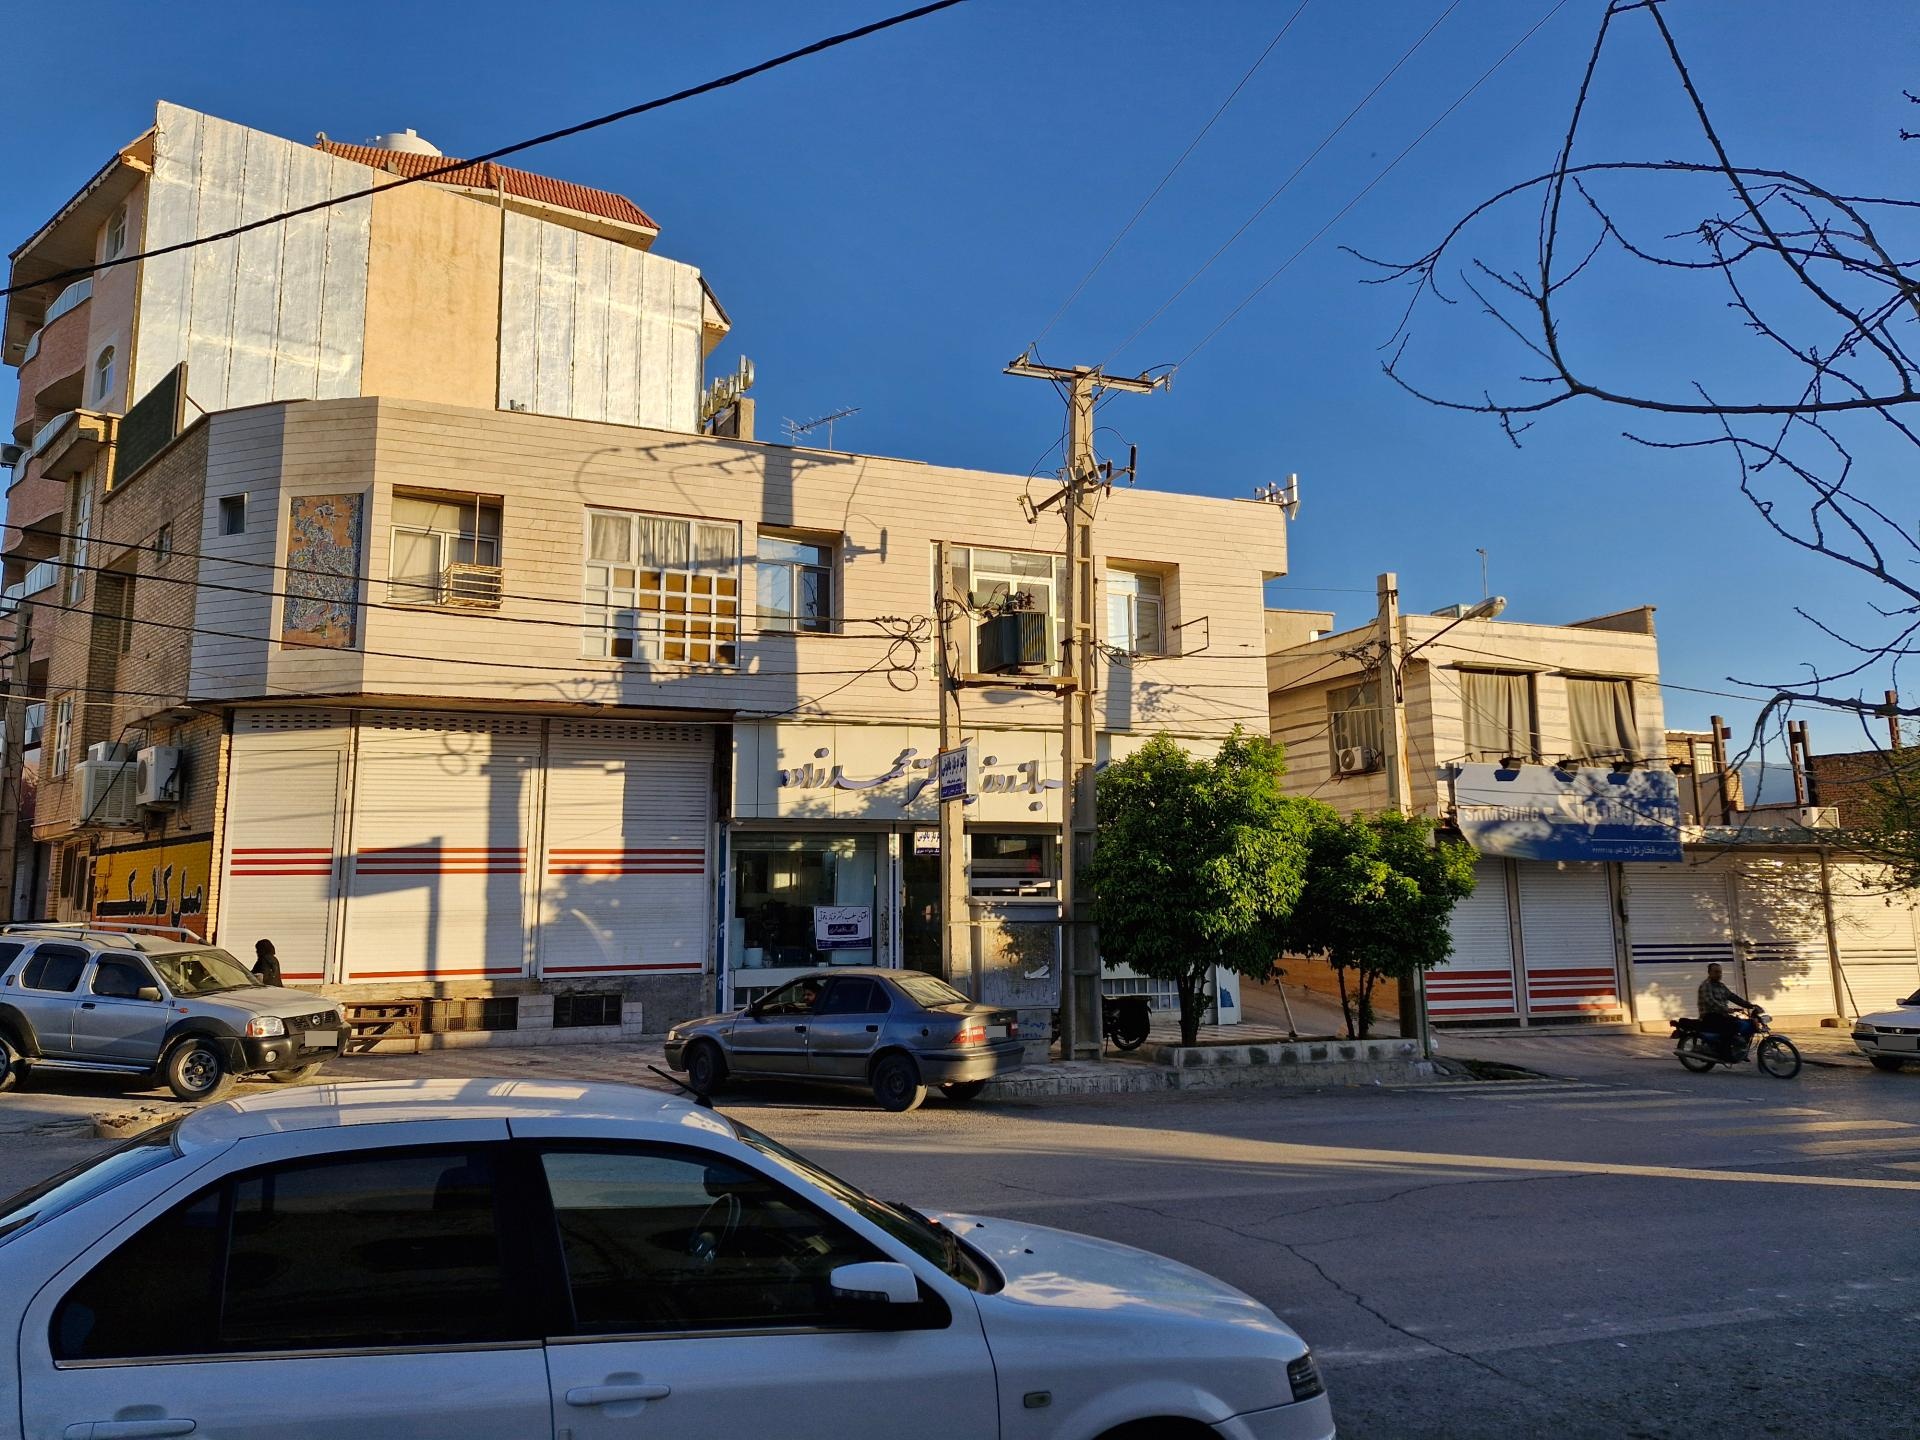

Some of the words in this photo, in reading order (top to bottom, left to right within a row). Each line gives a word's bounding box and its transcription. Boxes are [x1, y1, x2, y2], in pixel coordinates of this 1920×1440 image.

[1465, 806, 1540, 822] SAMSUNG
[96, 863, 174, 930] کلاسیک
[170, 868, 203, 942] مبل
